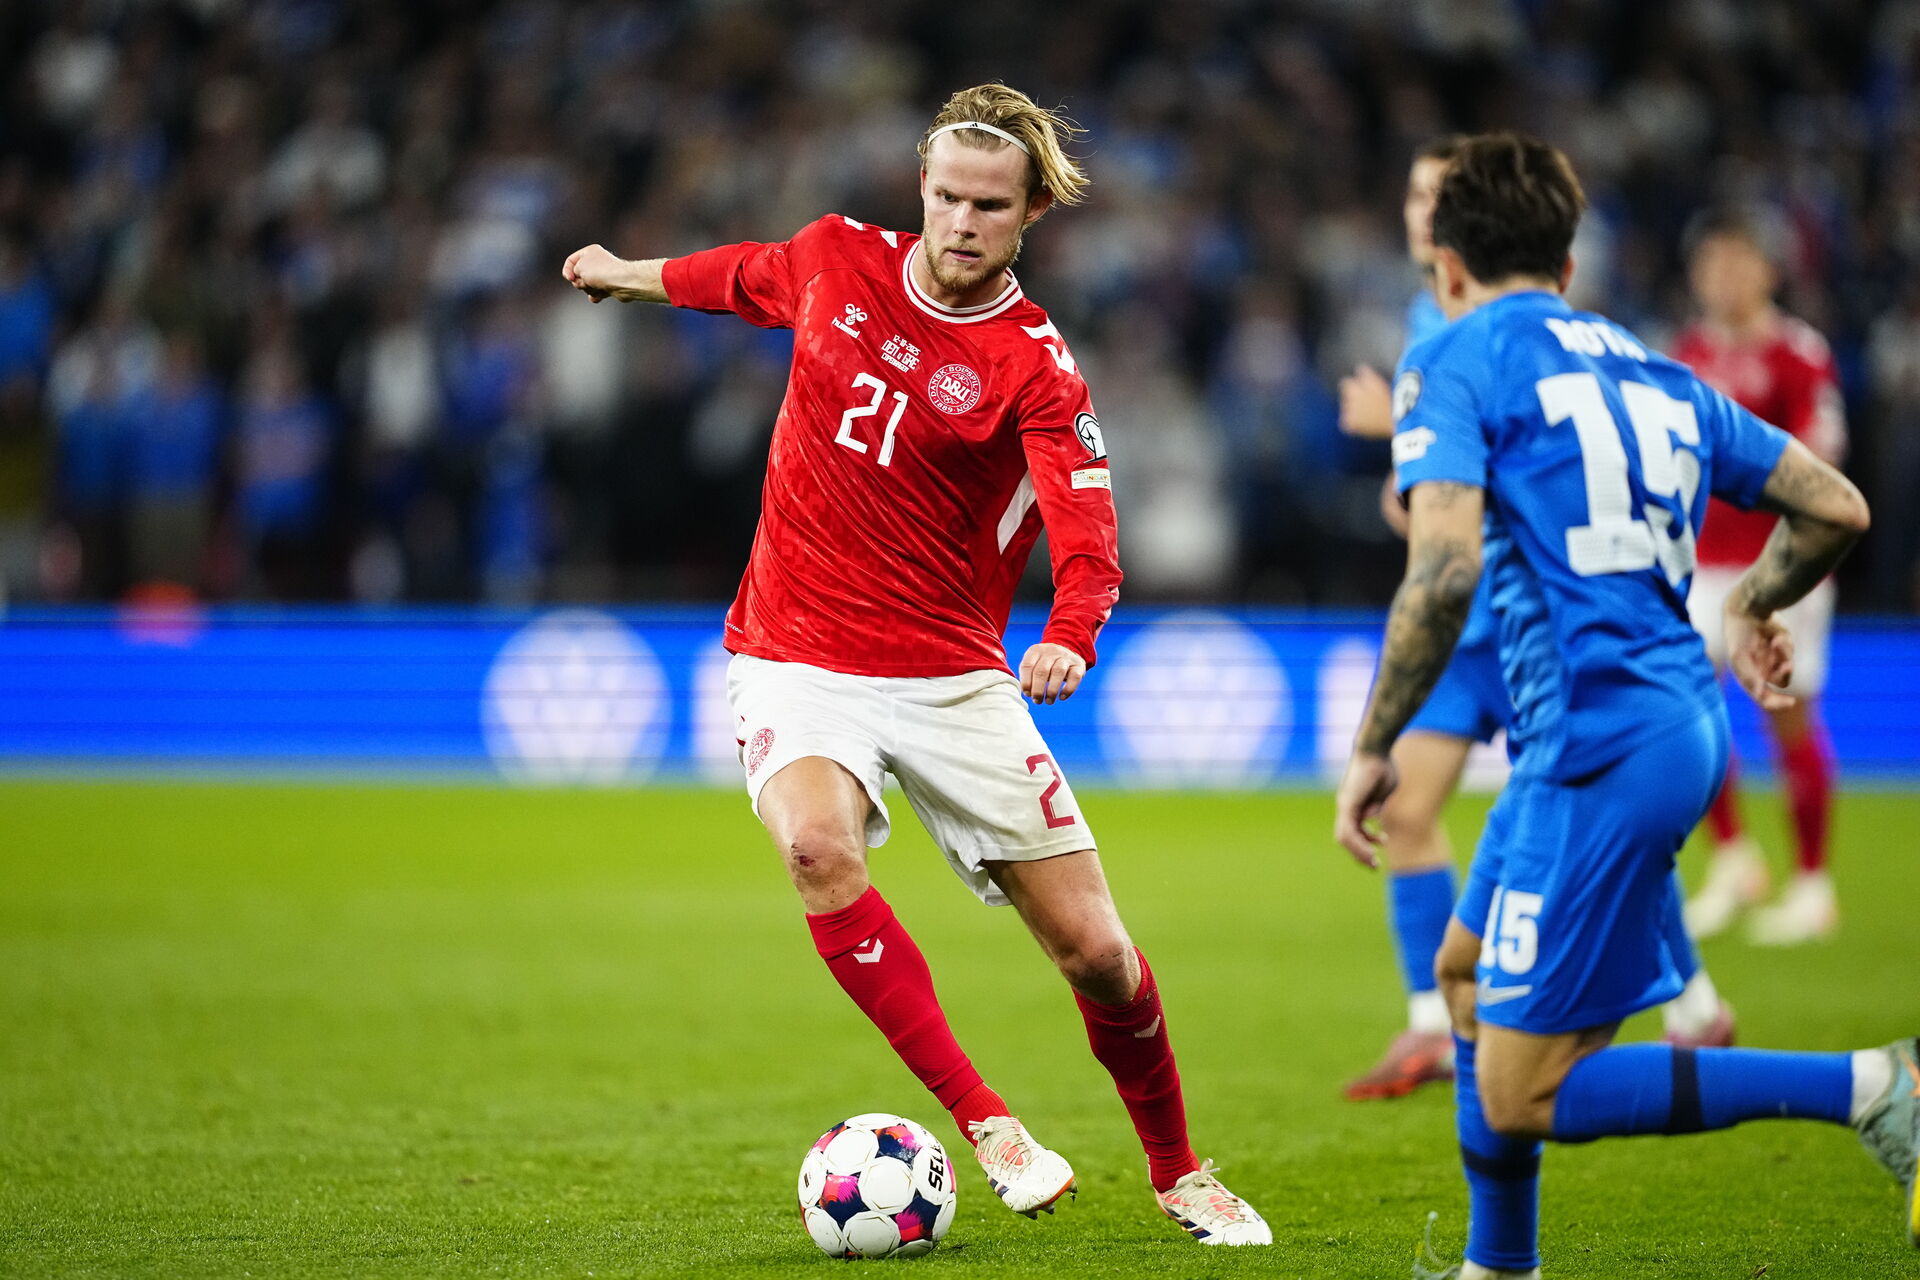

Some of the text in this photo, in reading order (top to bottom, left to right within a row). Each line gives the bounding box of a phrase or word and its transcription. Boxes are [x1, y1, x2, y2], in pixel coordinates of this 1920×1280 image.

[881, 339, 900, 357] DEN
[901, 352, 920, 370] GRE
[930, 369, 947, 397] DANSK
[956, 391, 979, 412] UNION
[934, 399, 954, 413] 1889
[939, 376, 970, 402] DBU
[834, 372, 909, 467] 21
[1535, 372, 1701, 588] 15
[1479, 885, 1543, 975] 15
